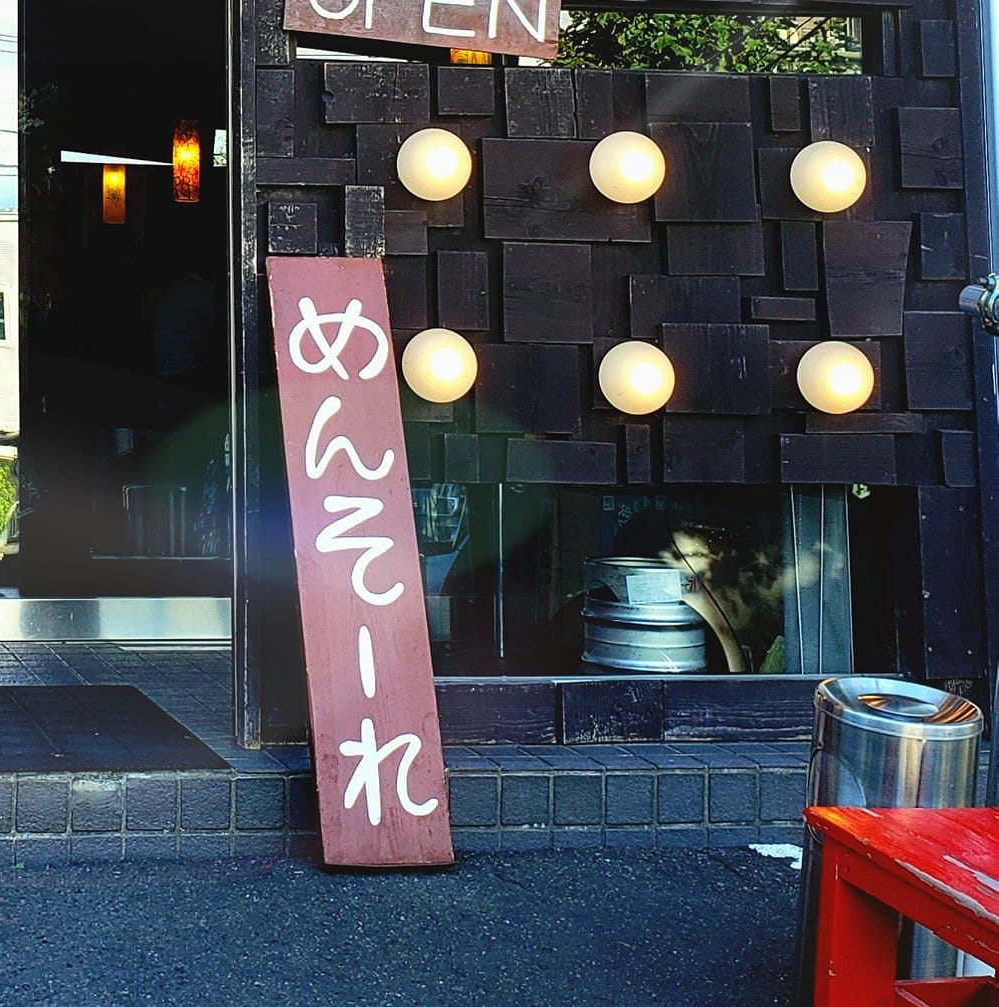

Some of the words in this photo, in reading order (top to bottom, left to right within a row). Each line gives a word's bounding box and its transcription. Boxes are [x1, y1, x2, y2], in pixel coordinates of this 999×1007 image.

[288, 296, 438, 827] めんそーれ
